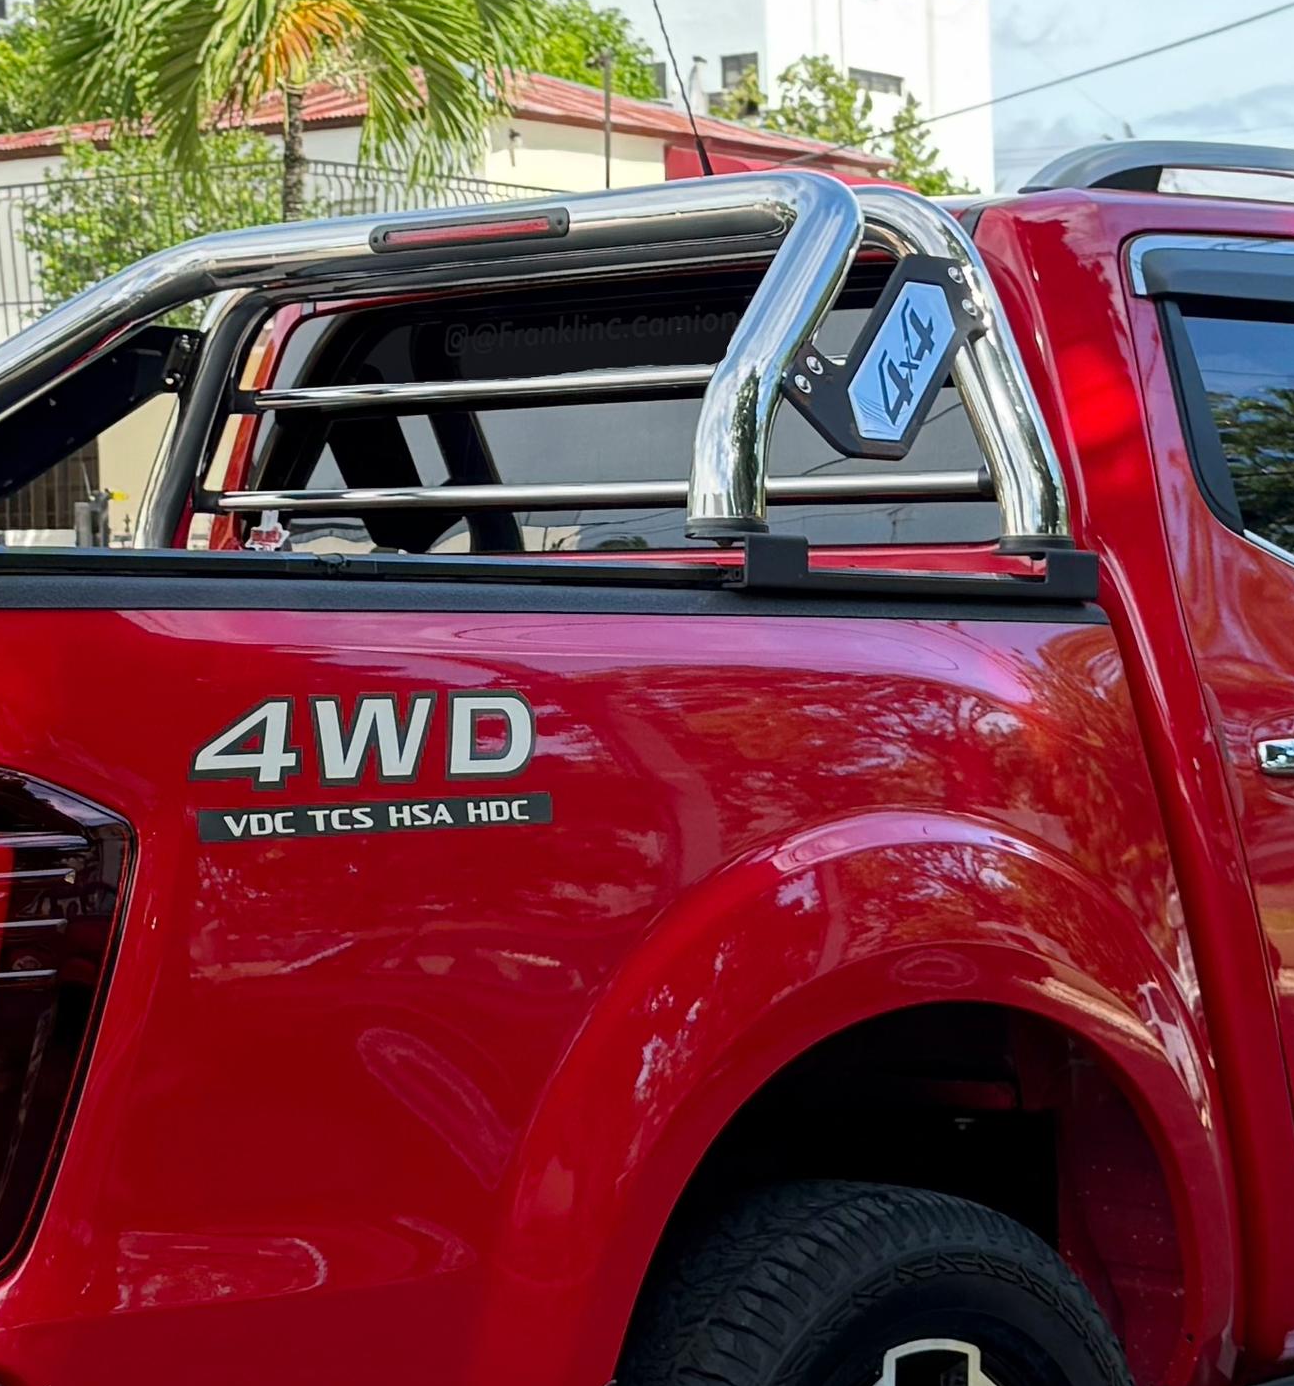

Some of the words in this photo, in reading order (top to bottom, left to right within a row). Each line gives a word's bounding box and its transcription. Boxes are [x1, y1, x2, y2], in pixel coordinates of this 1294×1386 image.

[191, 693, 534, 787] 4WD
[223, 811, 295, 837] VDC
[308, 807, 373, 832] TCS
[389, 803, 453, 827] HSA
[467, 800, 530, 823] HDC
